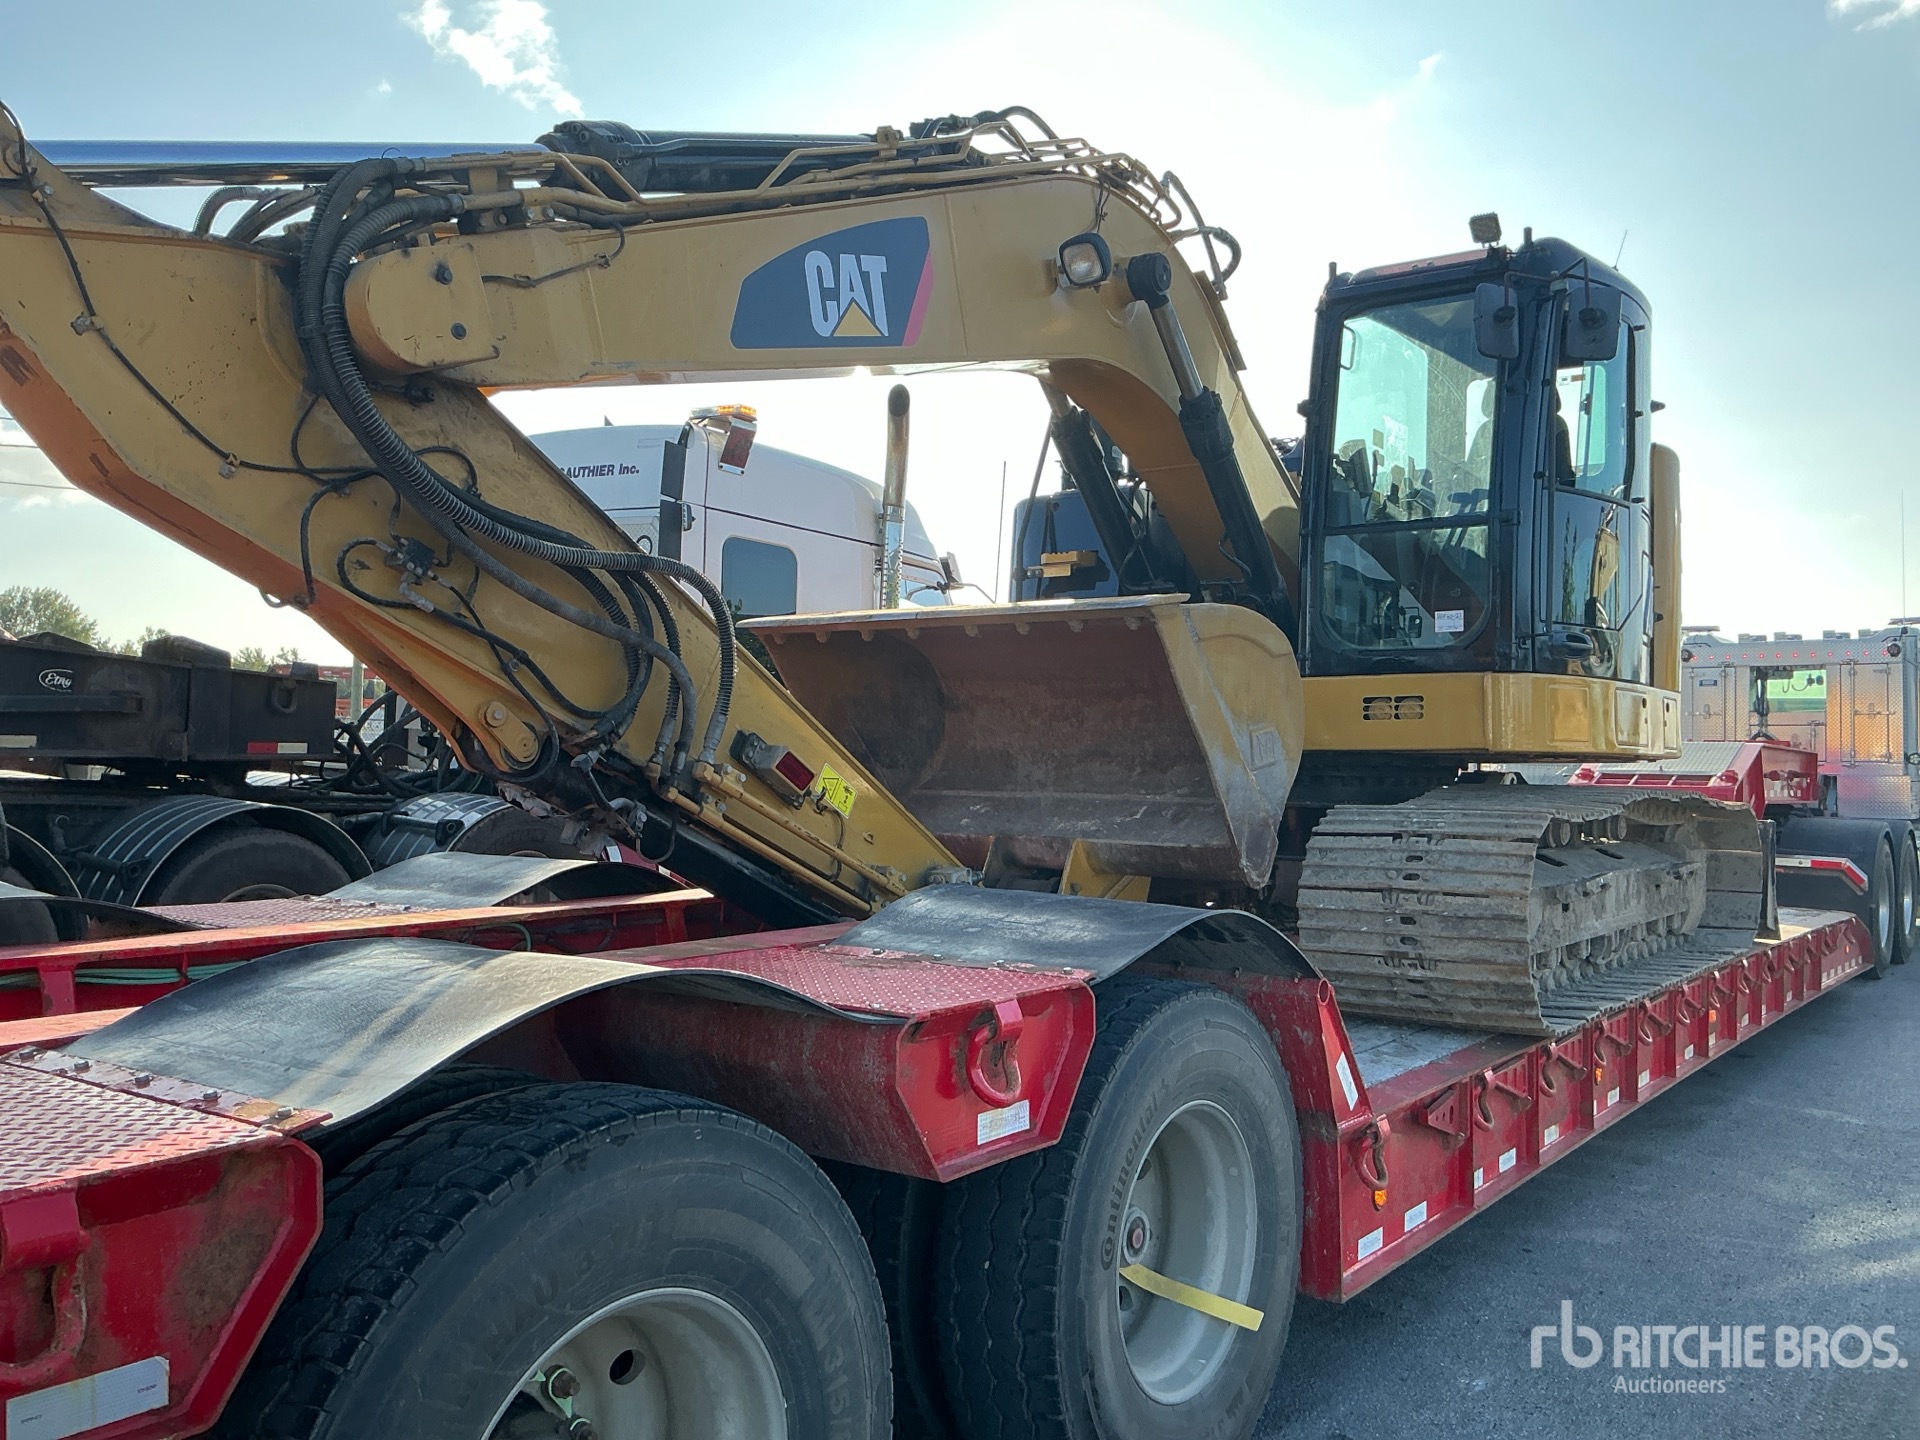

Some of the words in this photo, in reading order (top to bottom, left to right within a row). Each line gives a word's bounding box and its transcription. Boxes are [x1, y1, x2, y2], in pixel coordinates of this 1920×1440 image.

[804, 250, 889, 337] CAT
[560, 464, 615, 479] AUTHIER
[618, 463, 640, 475] Inc.
